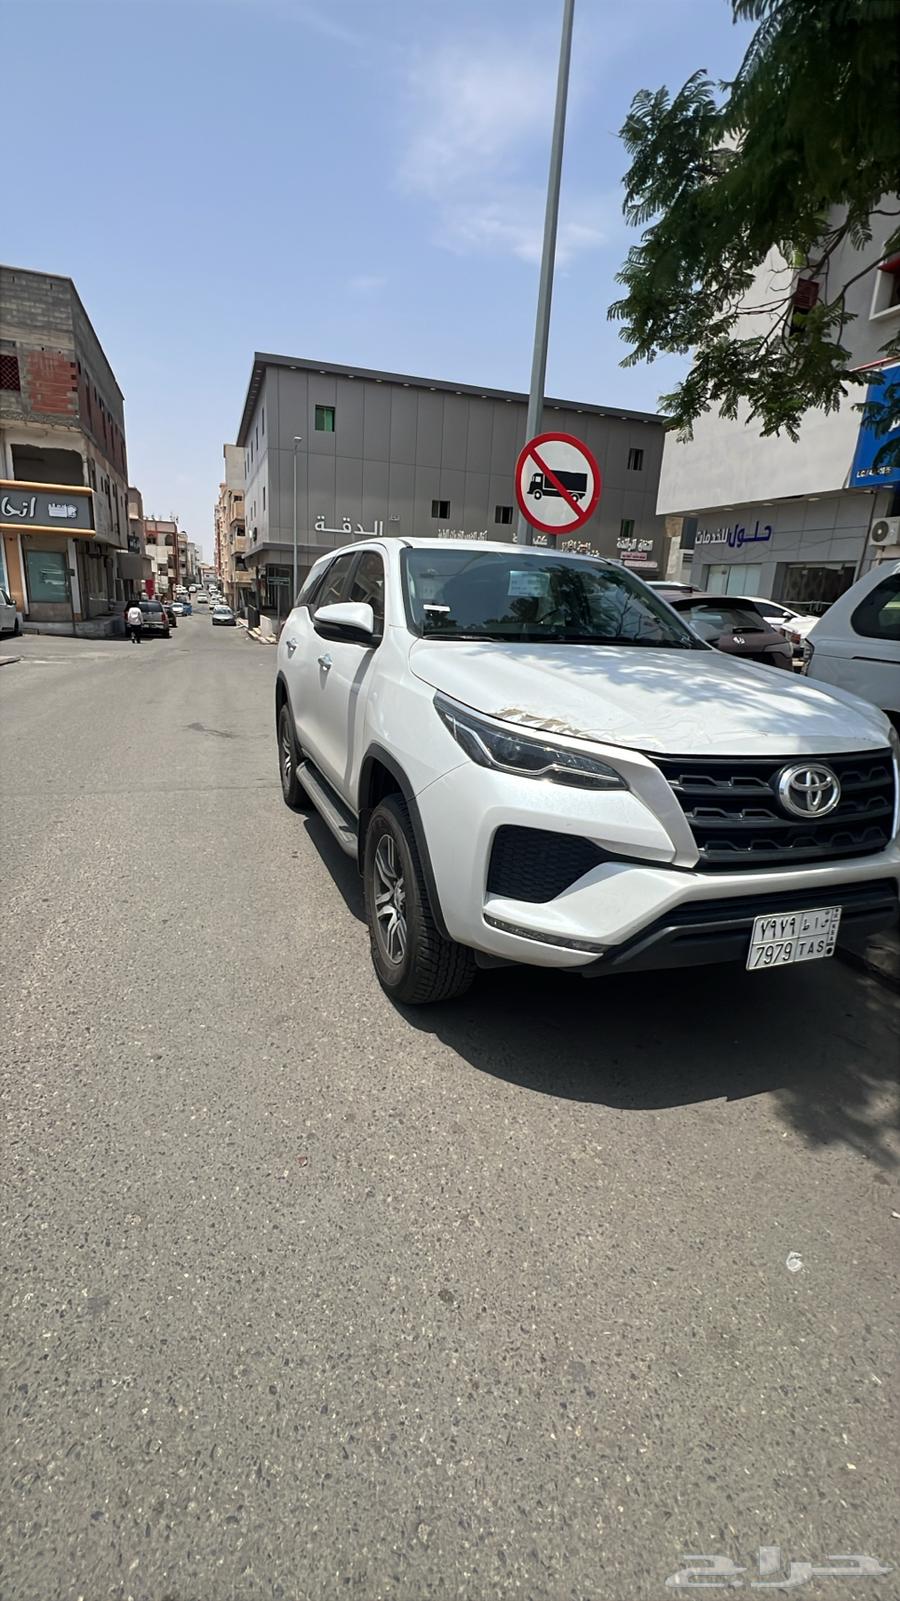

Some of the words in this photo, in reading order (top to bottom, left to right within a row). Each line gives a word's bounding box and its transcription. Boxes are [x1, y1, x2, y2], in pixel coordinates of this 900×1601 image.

[314, 515, 384, 536] الدقة
[695, 527, 728, 545] للخدمات
[728, 520, 772, 548] حلول
[760, 916, 796, 940] ٧٩٧٩
[754, 941, 793, 967] 7979
[799, 939, 825, 956] TAS
